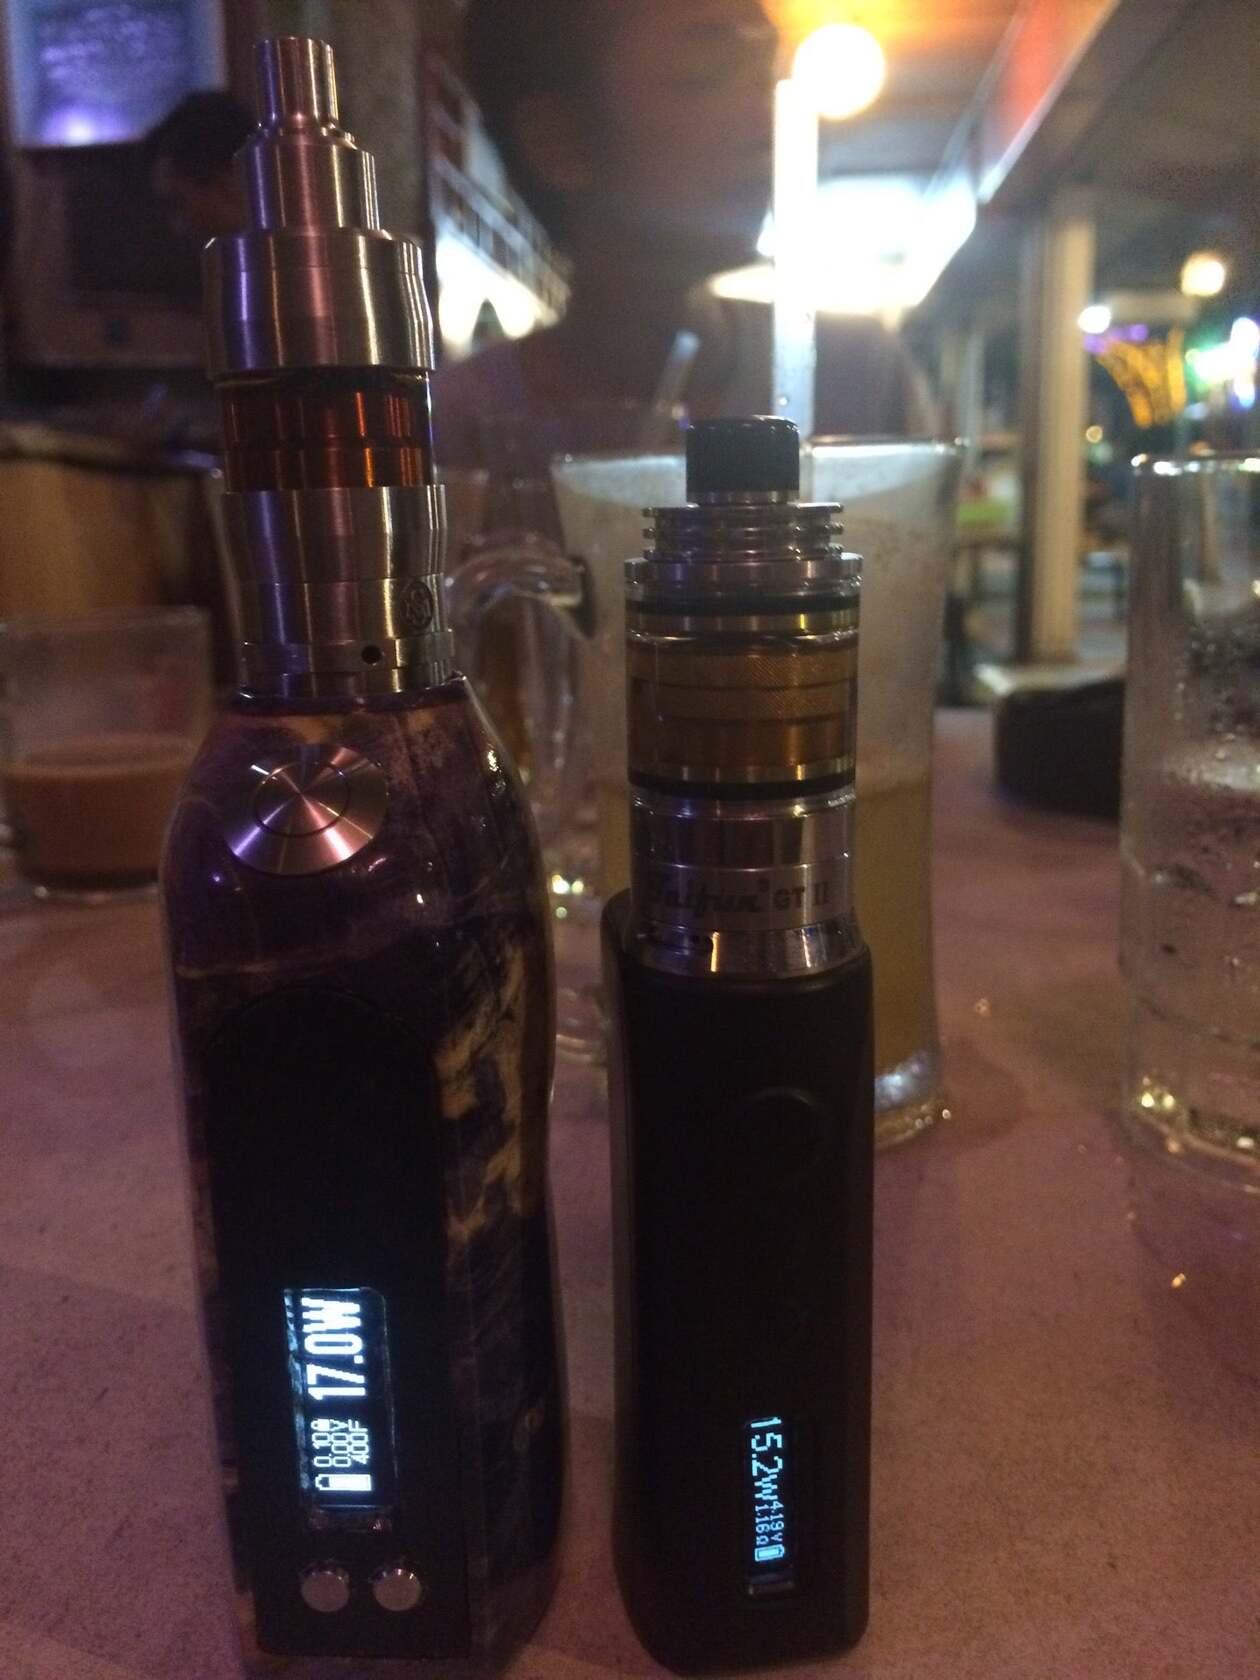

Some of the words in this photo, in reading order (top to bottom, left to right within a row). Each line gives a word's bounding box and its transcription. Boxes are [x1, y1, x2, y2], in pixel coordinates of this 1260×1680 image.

[301, 1297, 366, 1400] 17.0W
[330, 1419, 351, 1467] 0.00V
[348, 1419, 369, 1465] 400F
[751, 1416, 783, 1500] 15.2W
